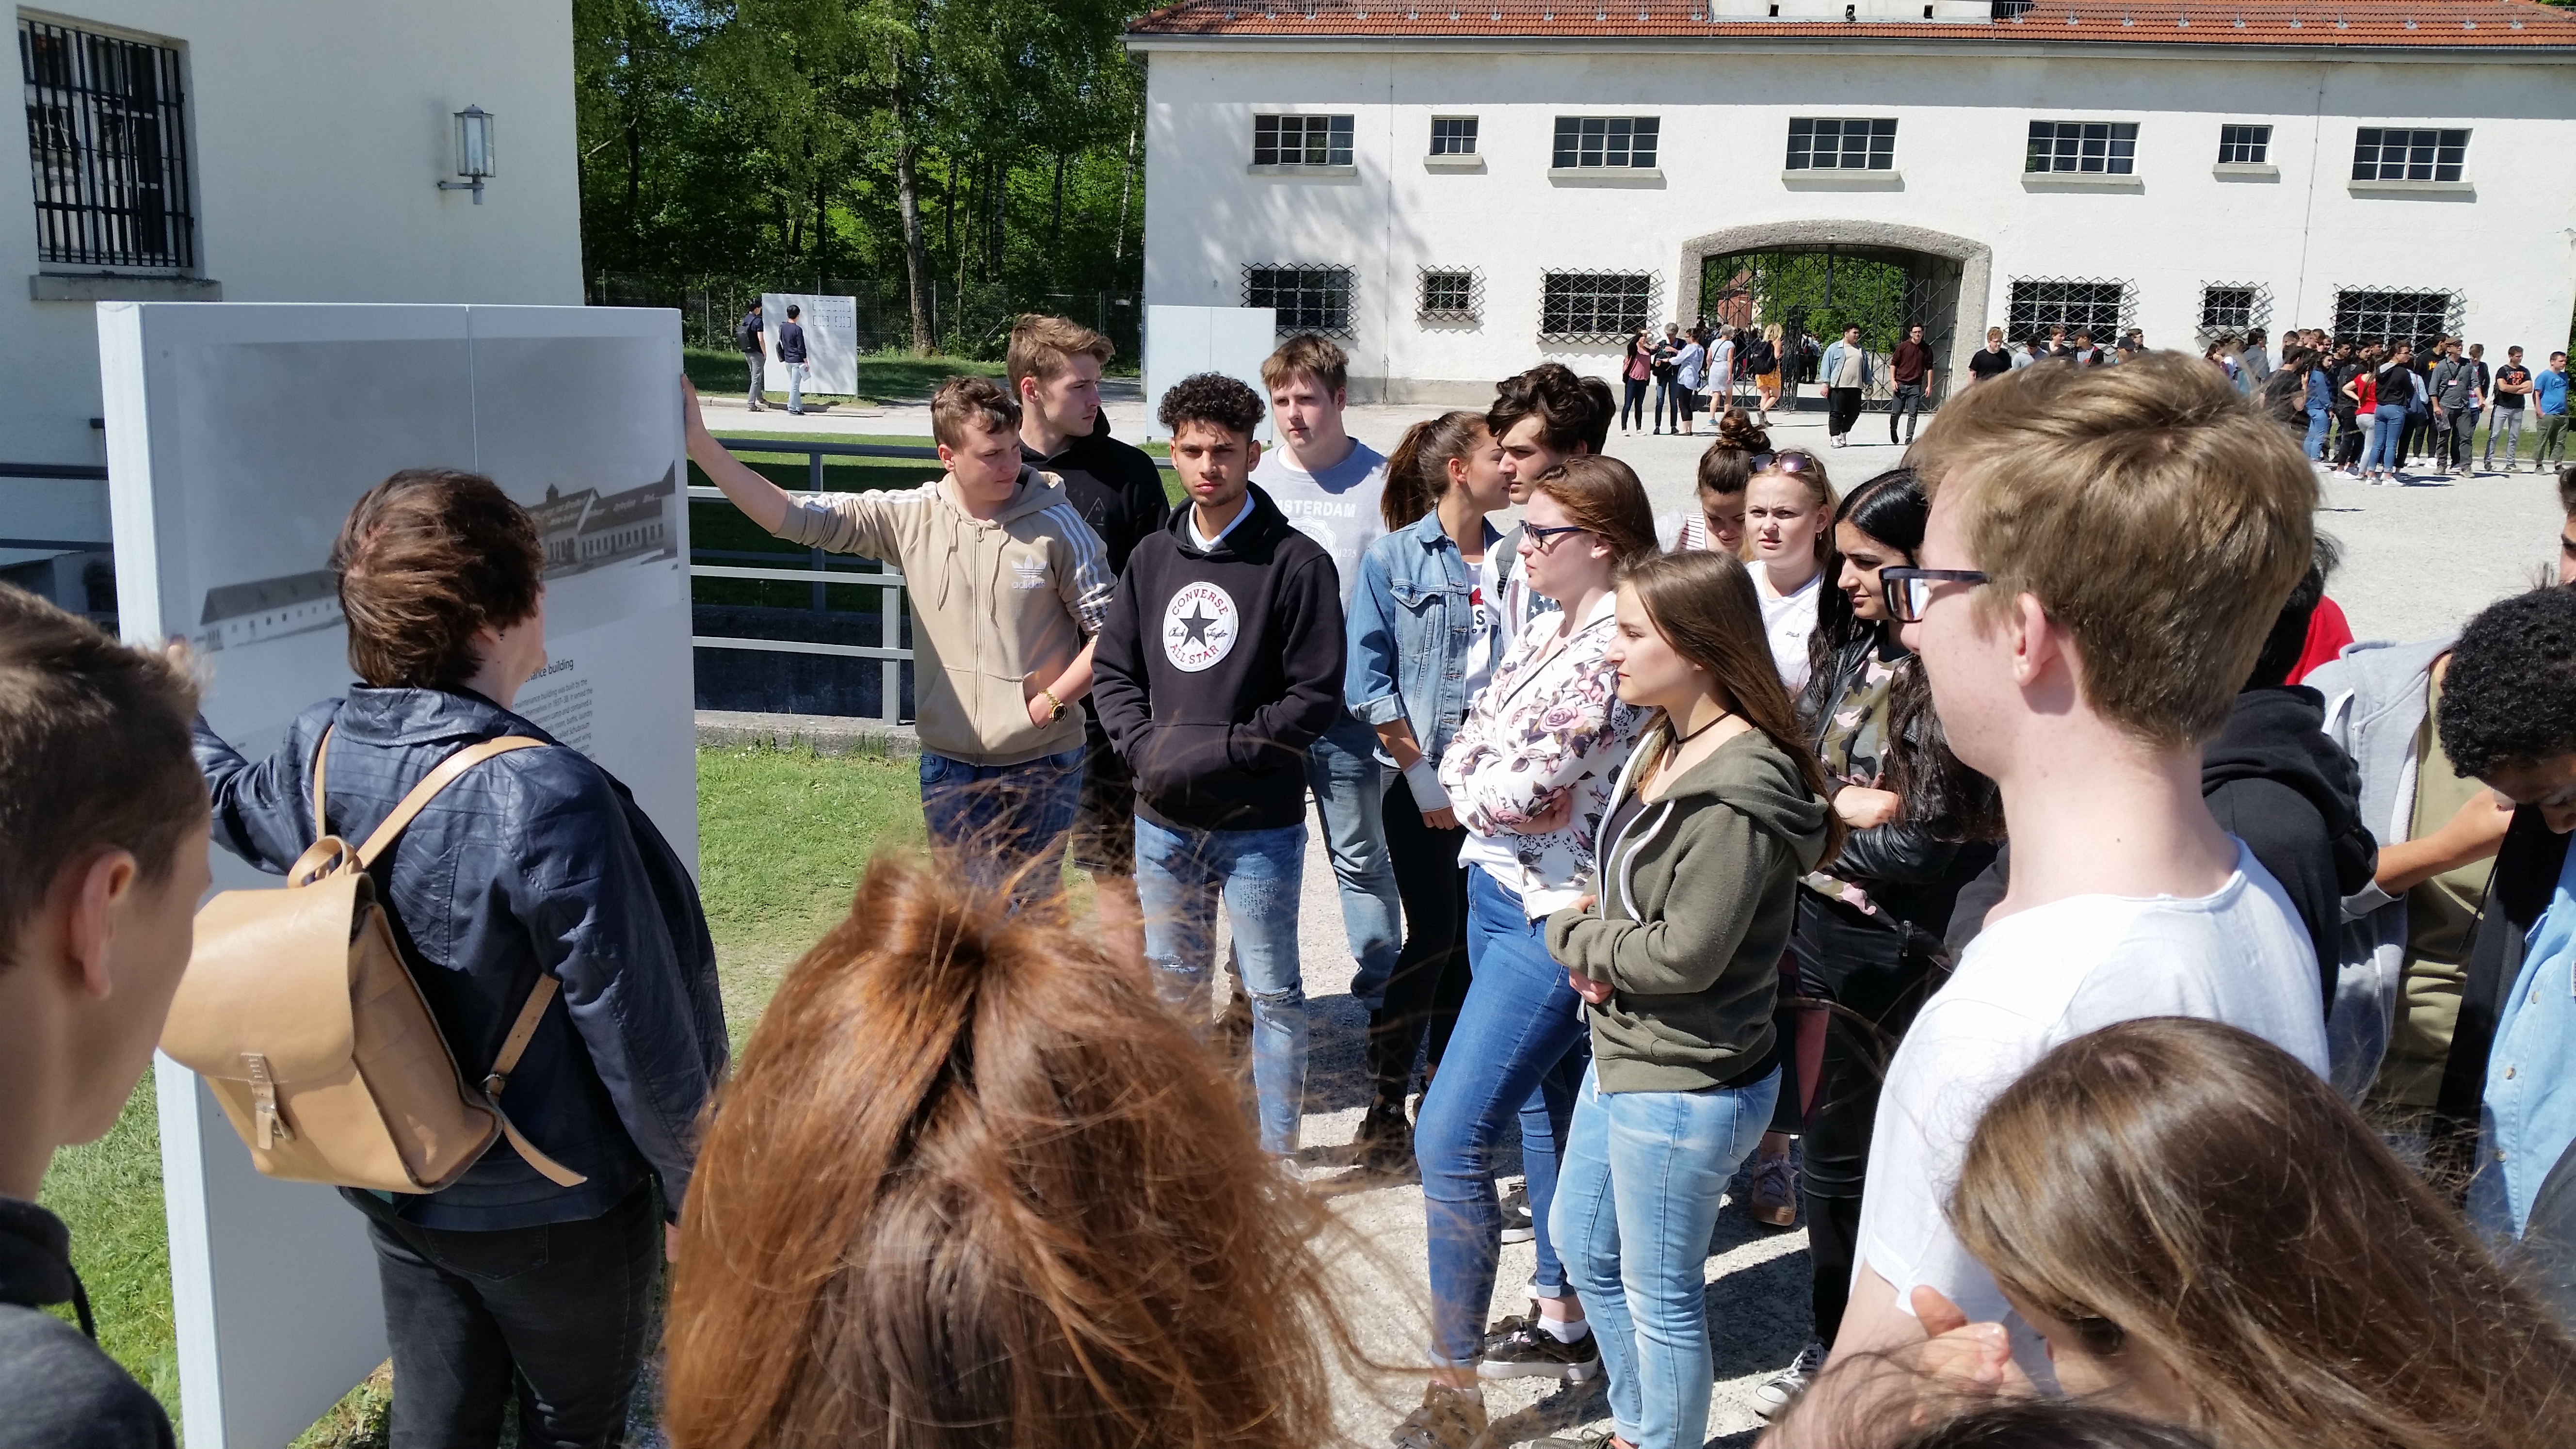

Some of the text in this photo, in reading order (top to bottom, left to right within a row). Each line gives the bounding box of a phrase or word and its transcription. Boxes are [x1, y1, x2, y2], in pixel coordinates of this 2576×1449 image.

[1274, 499, 1356, 517] MSTERDAM
[1338, 548, 1356, 558] 1275
[1012, 580, 1045, 589] adidas
[1172, 589, 1228, 615] CONVERSE
[1170, 644, 1219, 664] ALL STAR
[548, 660, 573, 674] building
